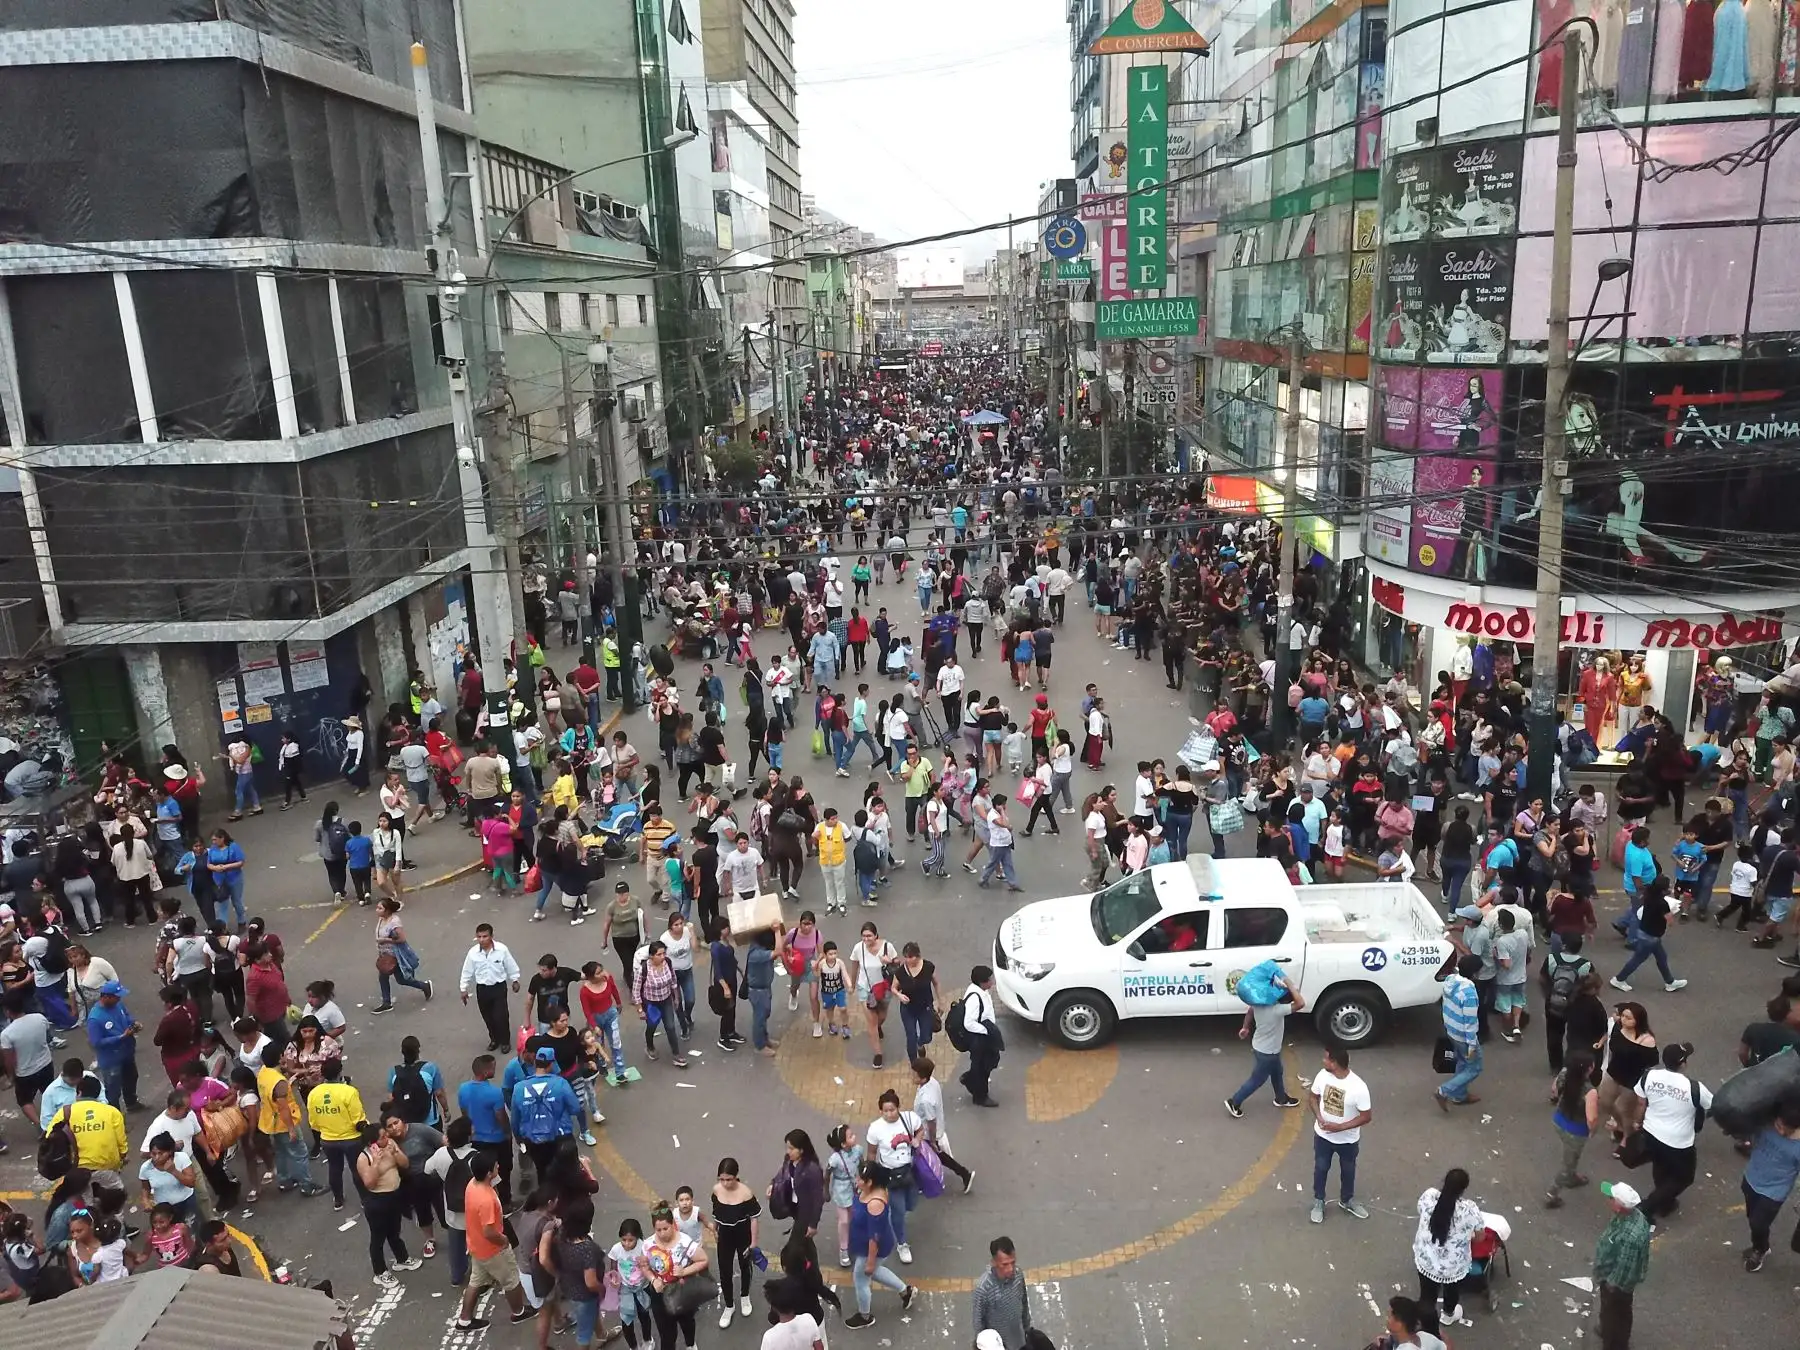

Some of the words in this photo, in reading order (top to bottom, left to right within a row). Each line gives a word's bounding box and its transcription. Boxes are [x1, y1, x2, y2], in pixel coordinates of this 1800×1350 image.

[1099, 40, 1109, 52] C.
[1115, 35, 1199, 50] COMERCIAL
[1453, 147, 1497, 168] Sachi
[1457, 164, 1493, 173] COLLECTION
[1483, 174, 1499, 183] Tda.
[1499, 172, 1514, 180] 309
[1496, 181, 1513, 189] Piso
[1137, 147, 1160, 284] TORRE
[1387, 253, 1419, 275] Sachi
[1439, 249, 1497, 274] Sachi
[1443, 272, 1491, 281] COLLECTION
[1492, 286, 1507, 294] 309
[1101, 304, 1119, 323] DE
[1122, 301, 1195, 322] GAMARRA
[1119, 324, 1165, 335] UNANUE
[1168, 323, 1189, 333] 1558
[1401, 946, 1440, 956] 423-9134
[1364, 951, 1386, 967] 24
[1401, 956, 1441, 966] 431-3000
[1124, 974, 1206, 986] PATRULLAJE
[1124, 984, 1207, 998] INTEGRADO
[314, 1105, 341, 1115] bitel
[73, 1121, 105, 1134] bitel
